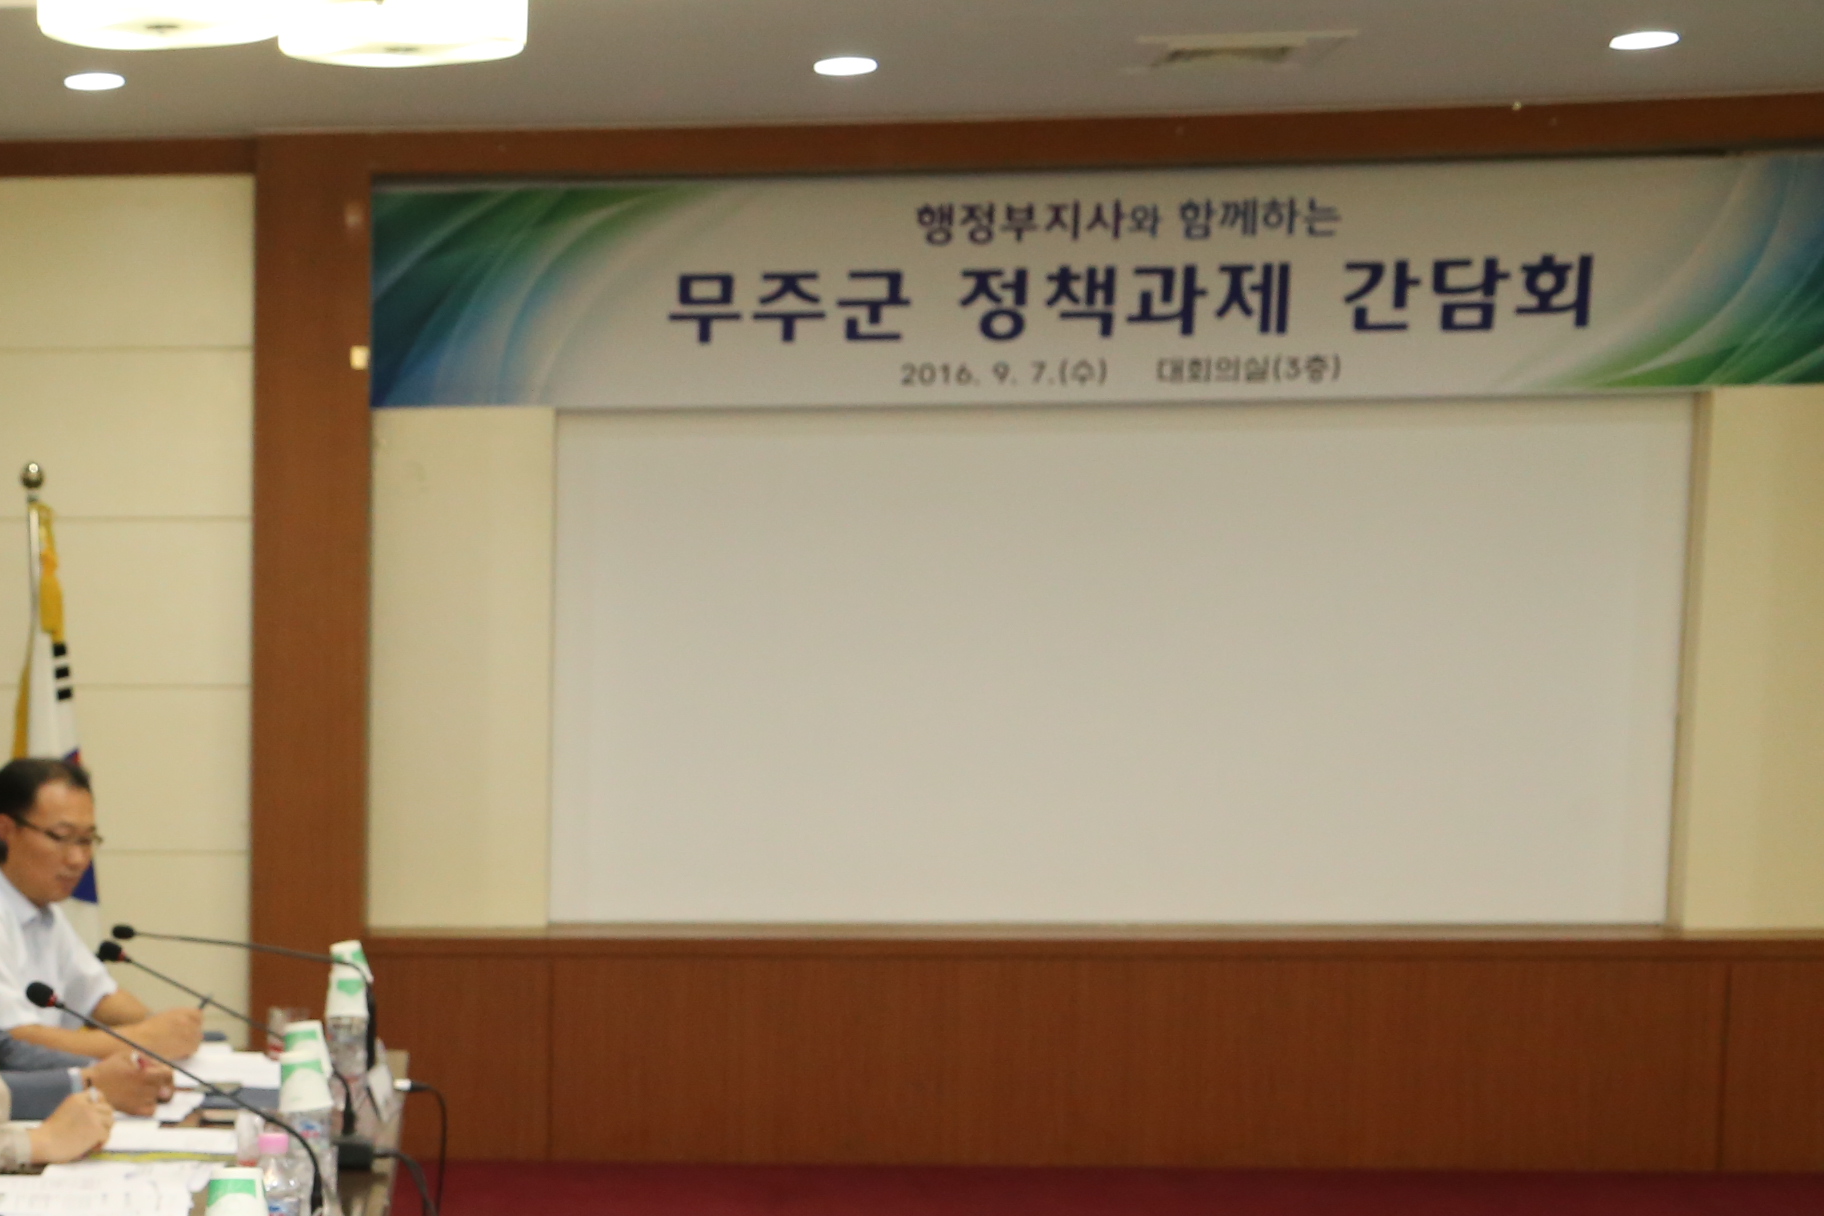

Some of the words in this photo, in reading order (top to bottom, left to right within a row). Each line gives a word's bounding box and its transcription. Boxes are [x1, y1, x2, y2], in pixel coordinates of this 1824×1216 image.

[916, 200, 1162, 246] 행정부지사와
[1179, 197, 1342, 241] 함께하는
[668, 269, 912, 345] 무주군
[959, 262, 1292, 343] 정책과제
[1343, 253, 1595, 333] 간담회
[901, 361, 980, 387] 2016.
[1155, 353, 1342, 385] 대회의실(3층)
